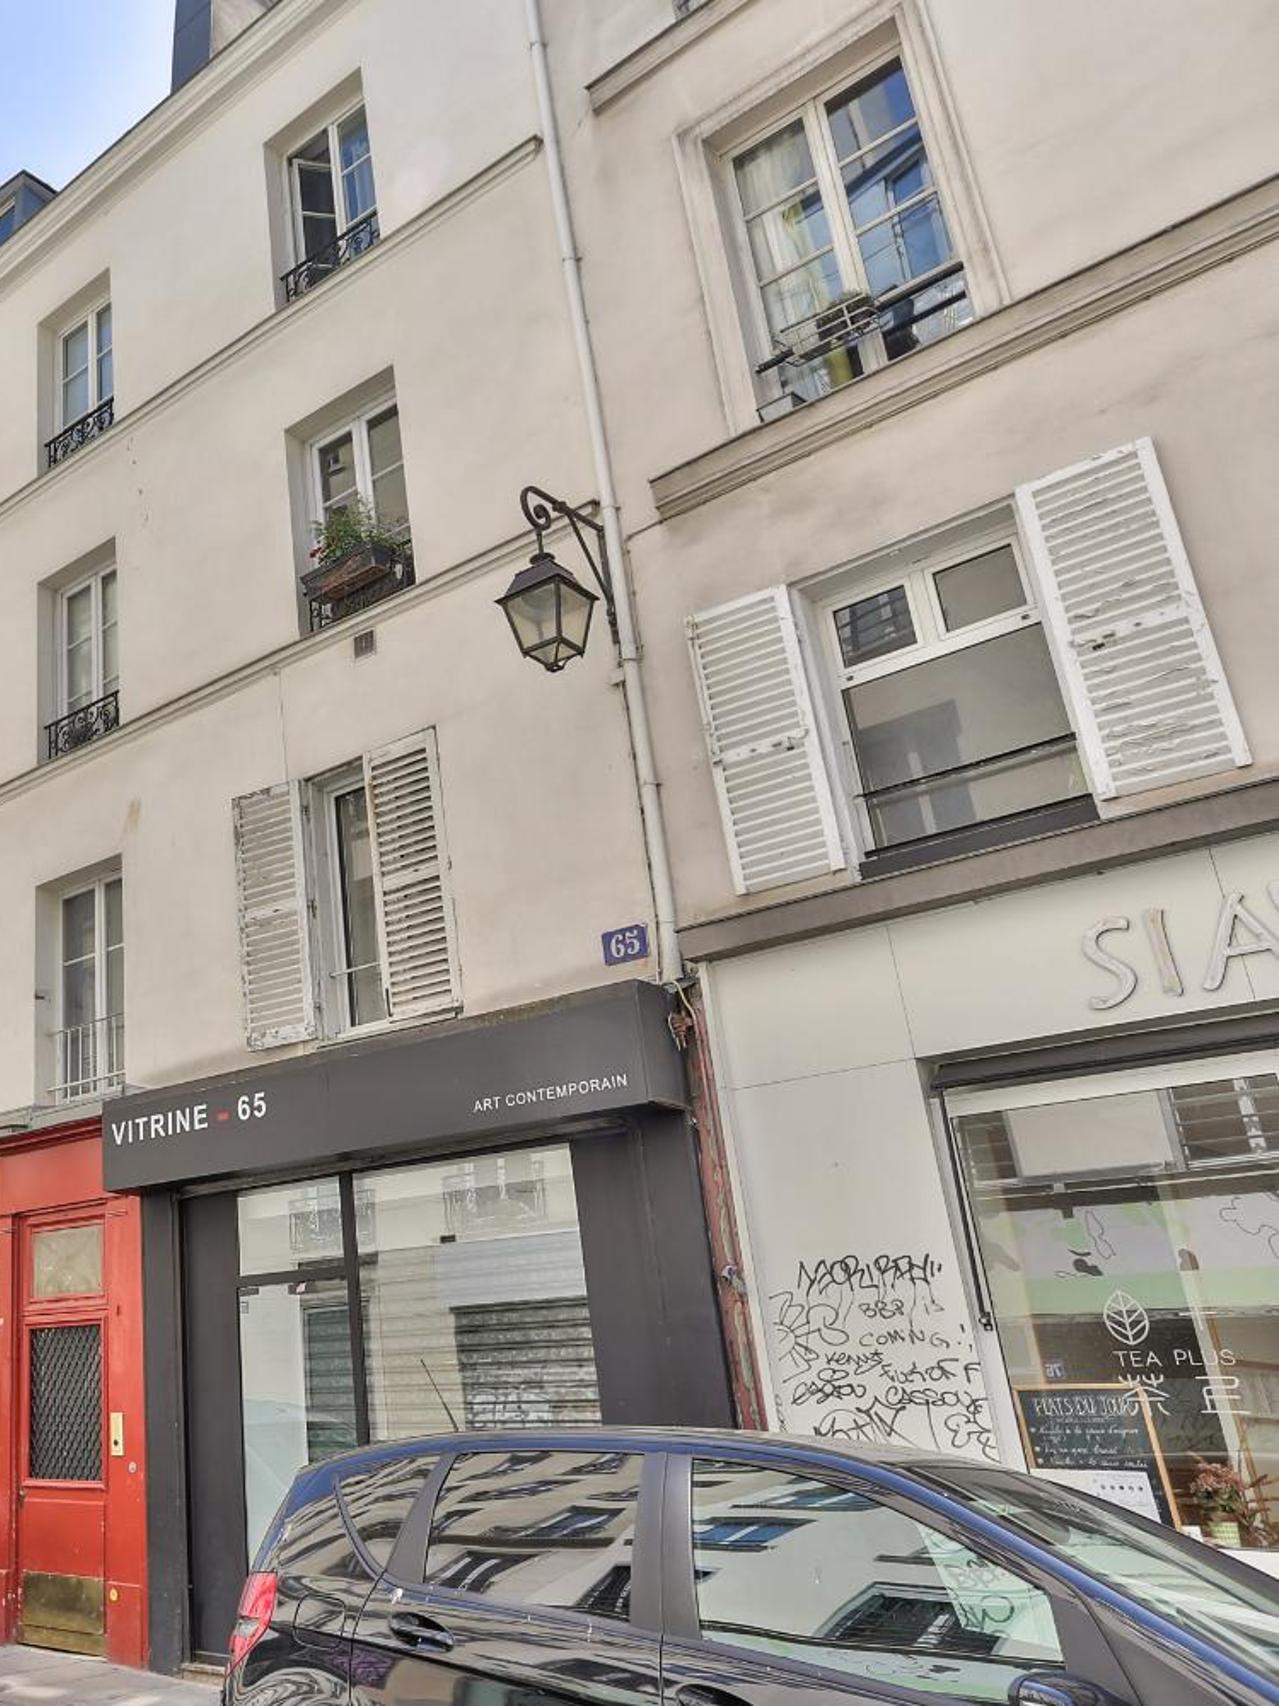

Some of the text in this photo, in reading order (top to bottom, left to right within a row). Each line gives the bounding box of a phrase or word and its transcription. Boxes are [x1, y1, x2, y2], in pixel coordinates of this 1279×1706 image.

[609, 929, 641, 959] 65
[1083, 880, 1279, 1011] SIA
[473, 1073, 628, 1113] ART CONTEMPORAIN
[111, 1103, 209, 1146] VITRINE
[236, 1091, 267, 1121] 65
[1112, 1348, 1237, 1368] TEA PLUS
[1033, 1396, 1073, 1417] PLATS
